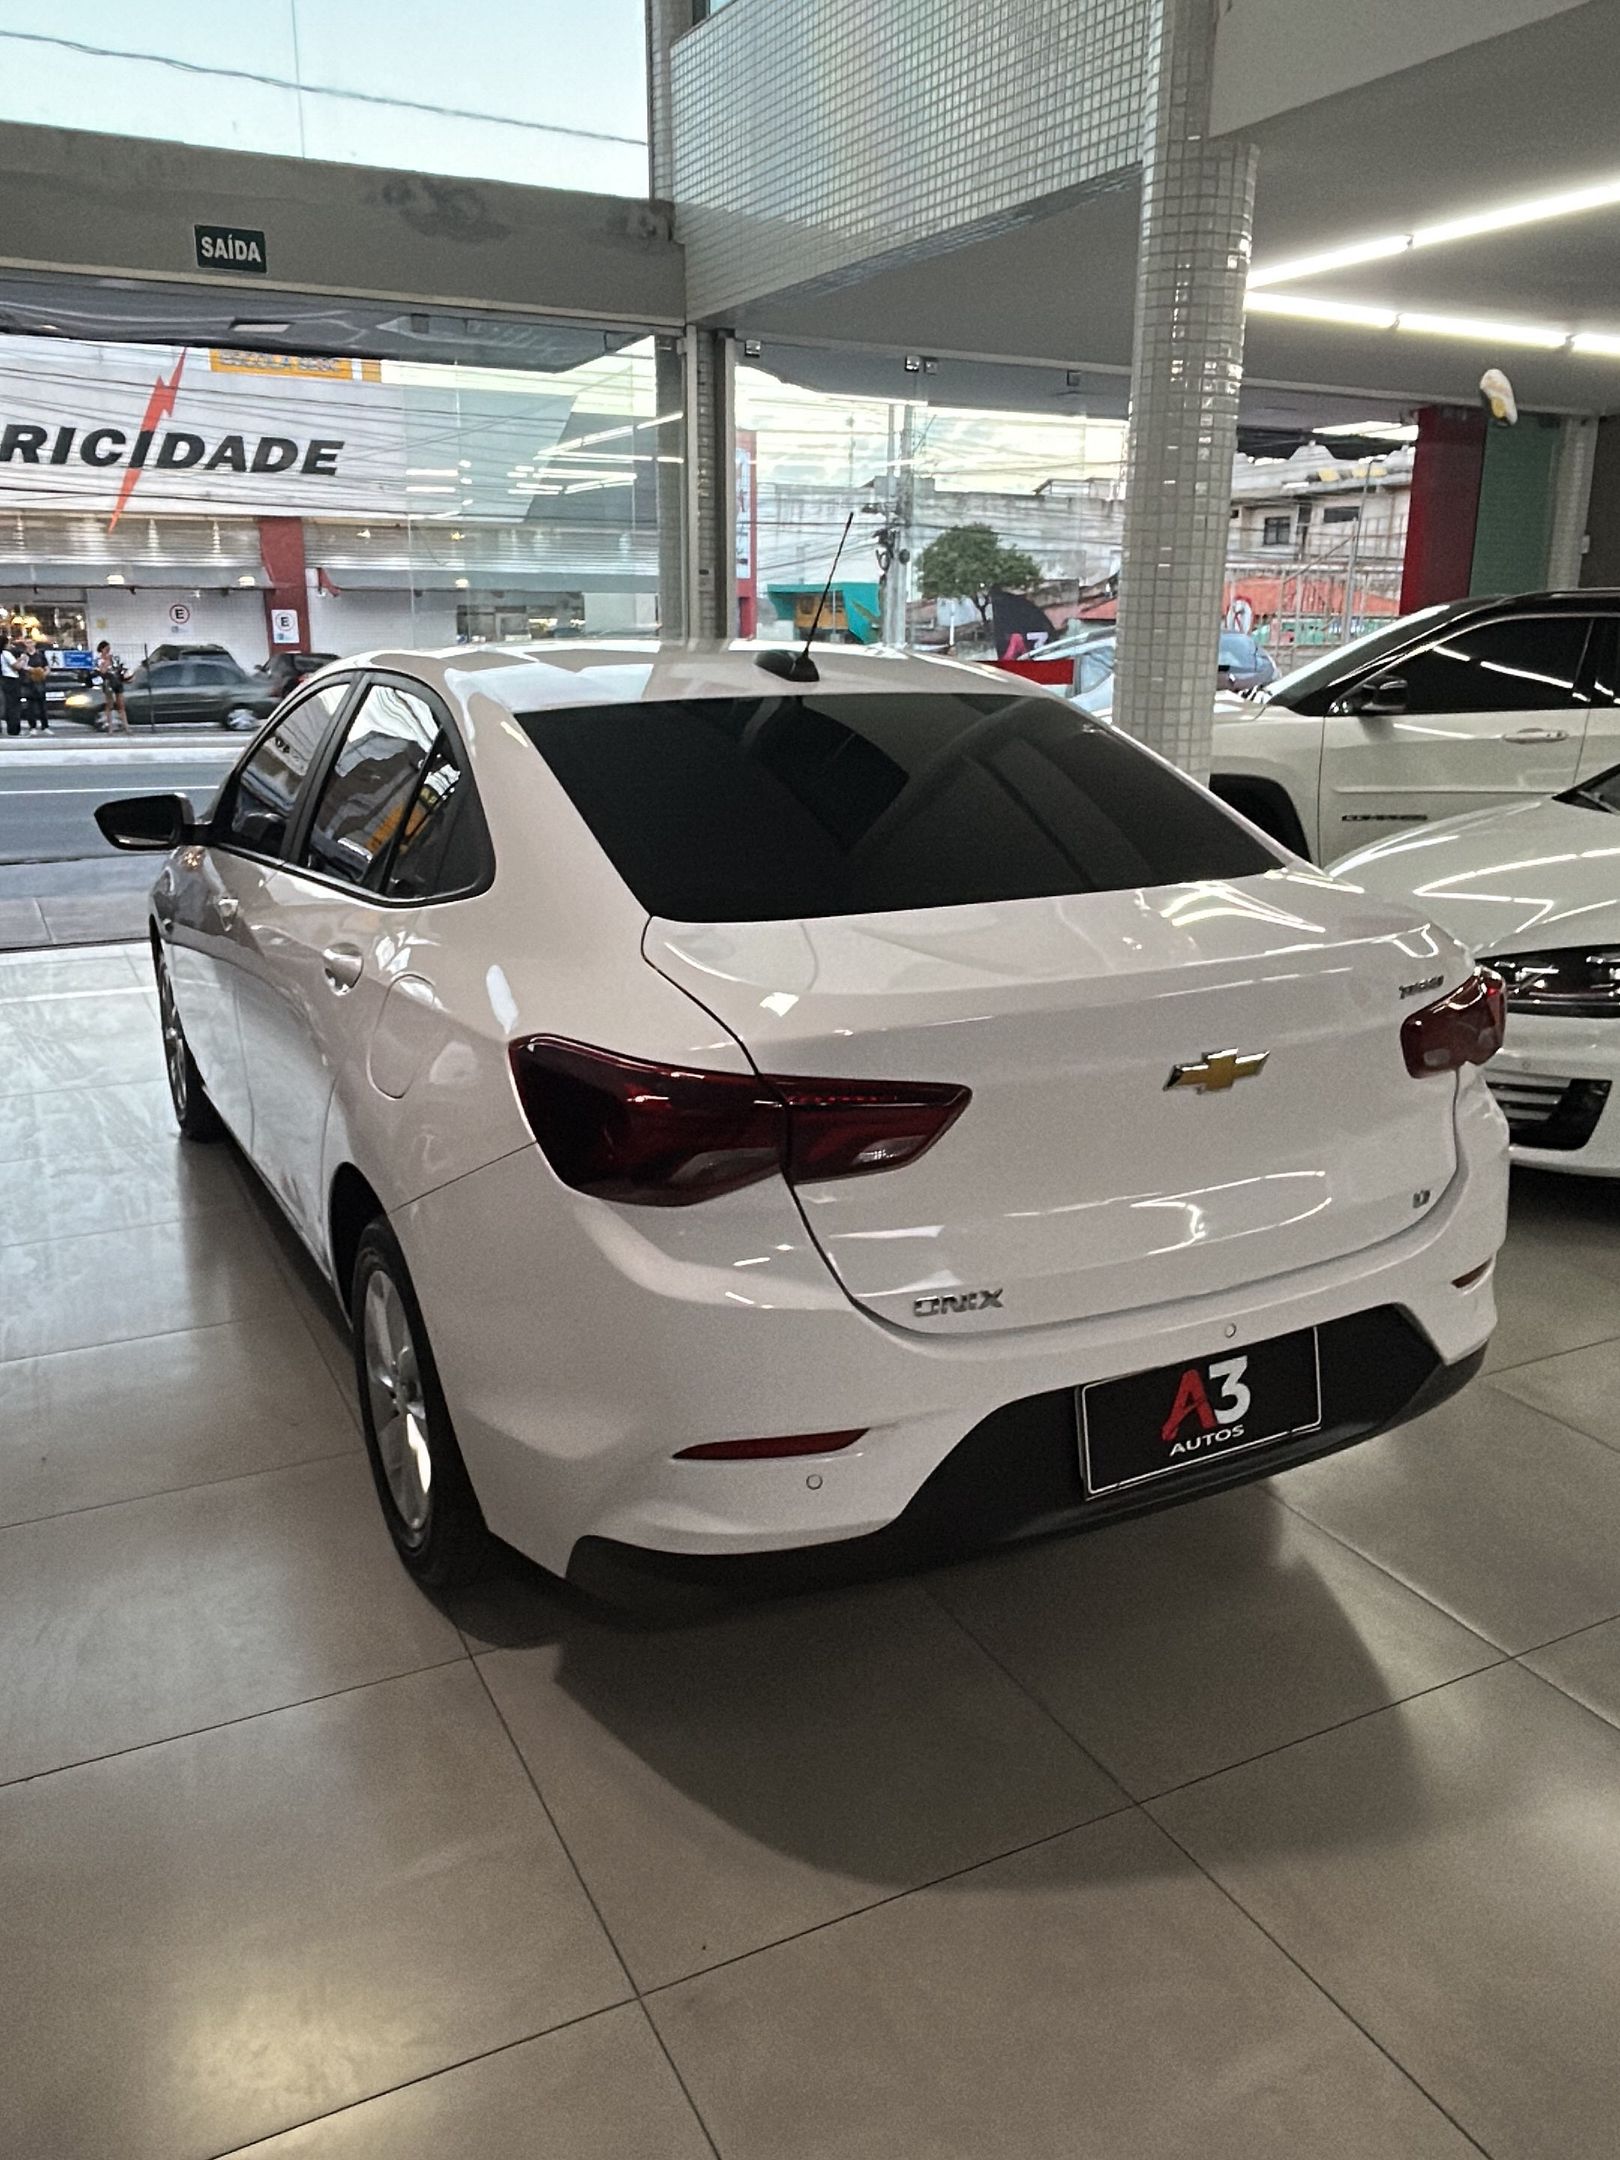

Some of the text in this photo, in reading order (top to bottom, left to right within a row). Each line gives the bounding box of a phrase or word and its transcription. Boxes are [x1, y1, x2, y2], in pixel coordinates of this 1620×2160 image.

[201, 233, 262, 262] SAÍDA
[0, 424, 345, 476] RICIDADE
[174, 608, 184, 620] E
[280, 616, 290, 627] E
[913, 1288, 1003, 1318] ONIX
[1160, 1355, 1251, 1441] A3
[1169, 1424, 1245, 1457] AUTOS
